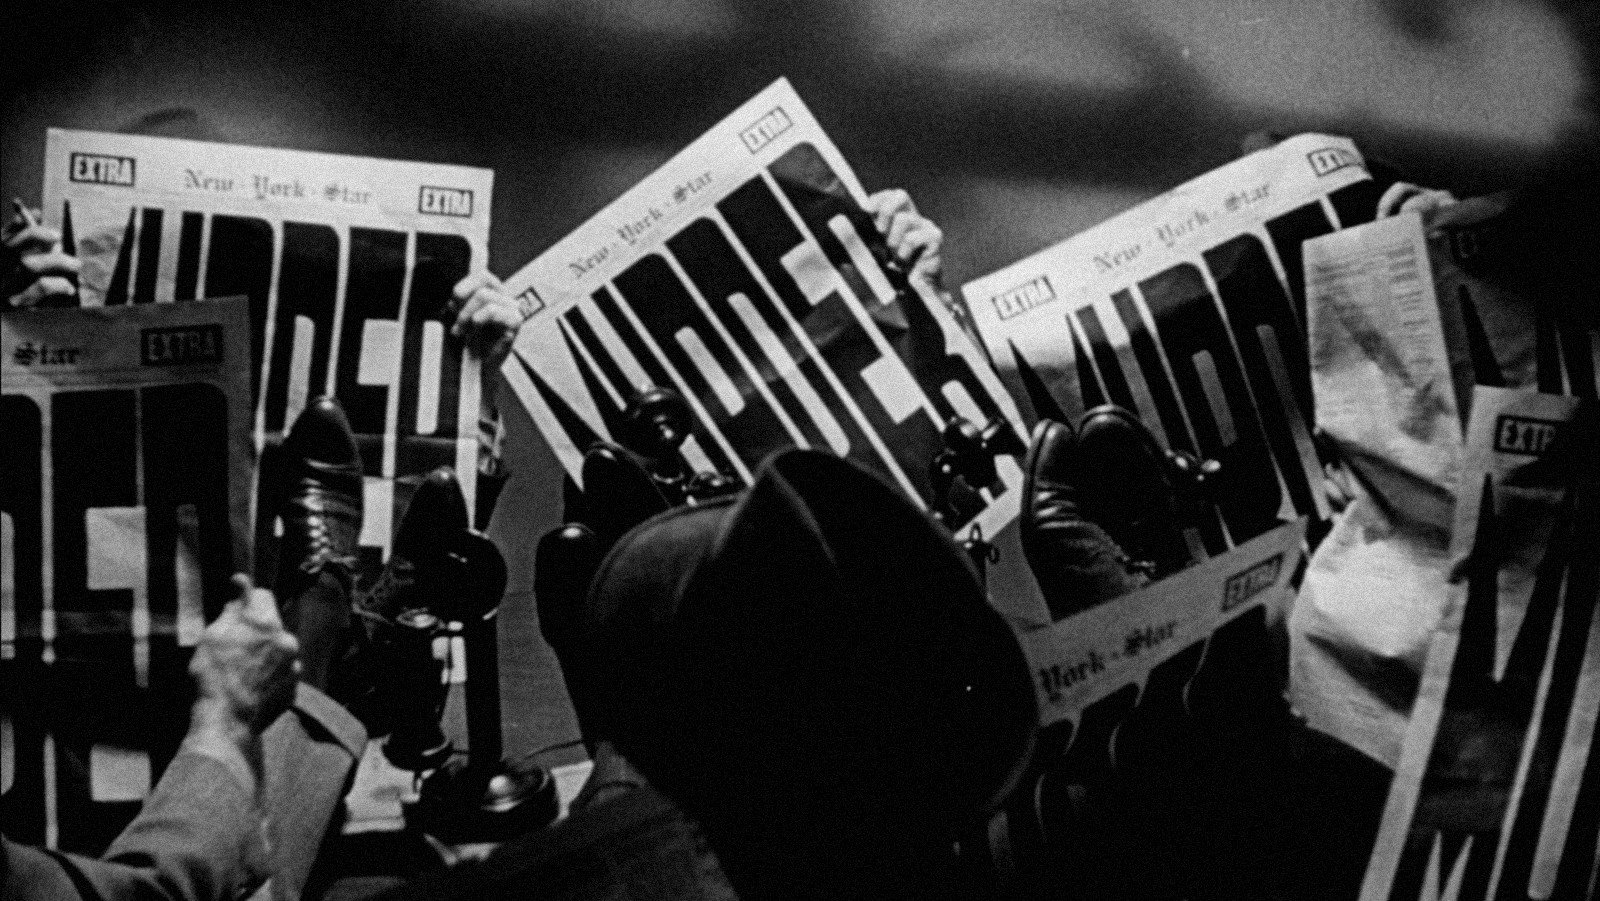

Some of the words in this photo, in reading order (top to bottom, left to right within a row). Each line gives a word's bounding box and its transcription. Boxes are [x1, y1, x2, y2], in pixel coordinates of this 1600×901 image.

[75, 156, 133, 183] EXTRA
[184, 167, 235, 191] New
[252, 174, 305, 201] York
[323, 184, 373, 205] Star
[424, 189, 471, 216] EXTRA
[568, 246, 611, 280] New
[616, 206, 663, 246] York
[672, 170, 714, 203] Star
[1092, 242, 1144, 274] New
[1155, 210, 1211, 247] York
[1223, 183, 1273, 212] Star
[995, 278, 1054, 317] EXTRA
[13, 341, 81, 367] Star
[146, 330, 219, 361] EXTRA
[1499, 418, 1558, 453] EXTR
[1038, 651, 1106, 703] York
[1122, 621, 1178, 657] Star
